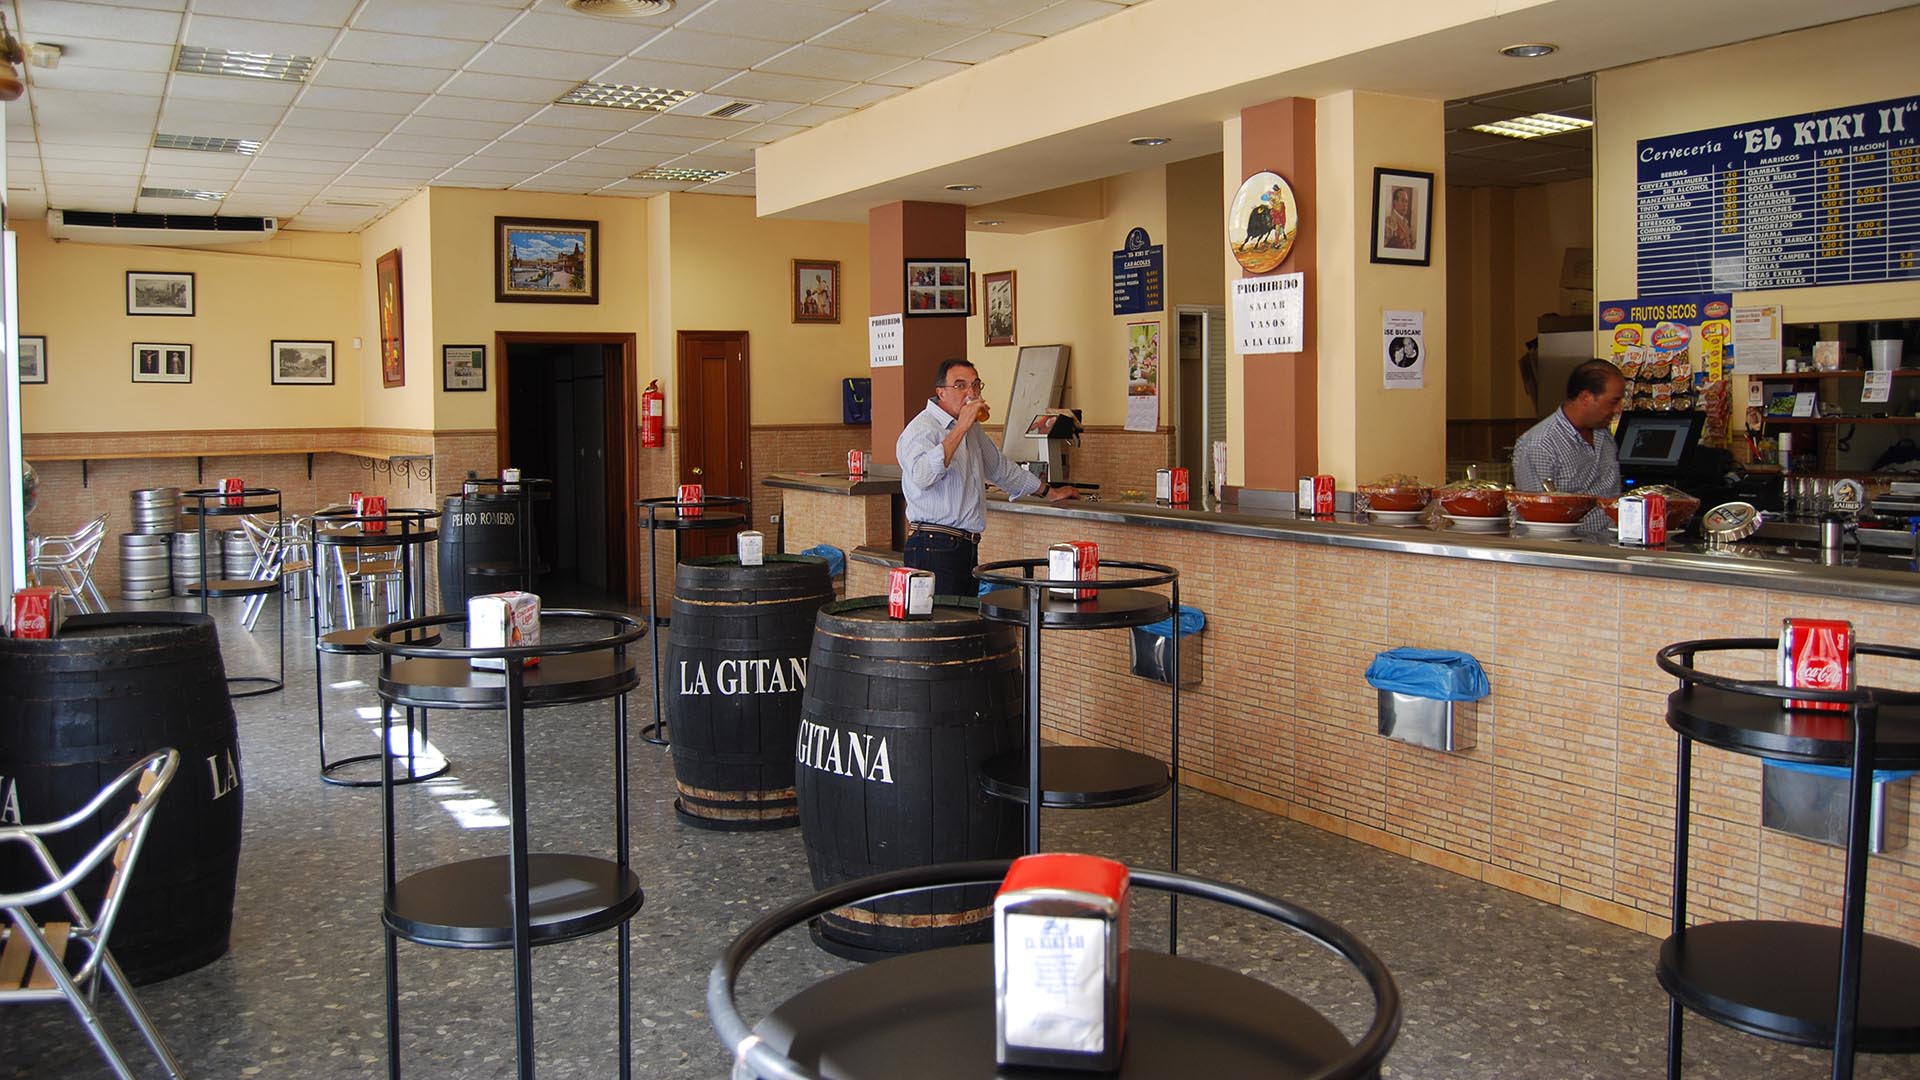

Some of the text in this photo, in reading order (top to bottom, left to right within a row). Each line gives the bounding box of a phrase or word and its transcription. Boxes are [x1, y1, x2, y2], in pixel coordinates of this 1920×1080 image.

[1640, 141, 1722, 163] Cervecería
[1733, 126, 1781, 154] "EL
[1794, 113, 1865, 146] KIKI
[1823, 148, 1844, 156] TAPA
[1853, 142, 1886, 152] RACION
[1760, 154, 1800, 165] MARISCOS
[1661, 169, 1688, 179] BEBIDAS
[1748, 167, 1781, 176] GAMBAS
[1640, 176, 1709, 190] CERVEZA SALMUERA
[1748, 173, 1798, 185] PATAS RUSAS
[1677, 185, 1710, 194] ALCOHOL
[1640, 195, 1686, 206] MANZANILLA
[1748, 198, 1797, 209] CAMARONES
[1640, 201, 1692, 213] TINTO VERANO
[1748, 206, 1792, 216] MEJILLONES
[1640, 212, 1659, 220] RIOJA
[1749, 213, 1802, 224] LANGOSTINOS
[1640, 218, 1676, 228] REFRESCOS
[1748, 222, 1793, 232] CANGREJOS
[1640, 226, 1682, 235] COMBINADO
[1748, 231, 1783, 240] MOJAMA
[1640, 234, 1671, 242] WHISKYS
[1748, 239, 1772, 248] HUEVAS
[1785, 236, 1813, 245] MARUCA
[1748, 247, 1783, 255] BACALAO
[1748, 252, 1810, 263] TORTILLA CAMPERA
[1124, 259, 1151, 267] CARACOLES
[1748, 263, 1780, 272] CIGALAS
[1748, 270, 1802, 280] PATAS EXTRAS
[1237, 279, 1298, 295] PROHIBIDO
[1748, 278, 1806, 288] BOCAS EXTRAS
[1249, 300, 1285, 311] SACAR
[1631, 303, 1697, 321] FRUTOS SECOS
[872, 317, 901, 327] PROHIBIDO
[1250, 319, 1285, 329] VASOS
[1243, 336, 1294, 347] A LA CALLE
[1833, 502, 1860, 510] KALIBER
[452, 513, 477, 527] PERO
[680, 657, 808, 695] LA GITAN
[798, 719, 894, 784] GITANA
[207, 748, 240, 801] LA
